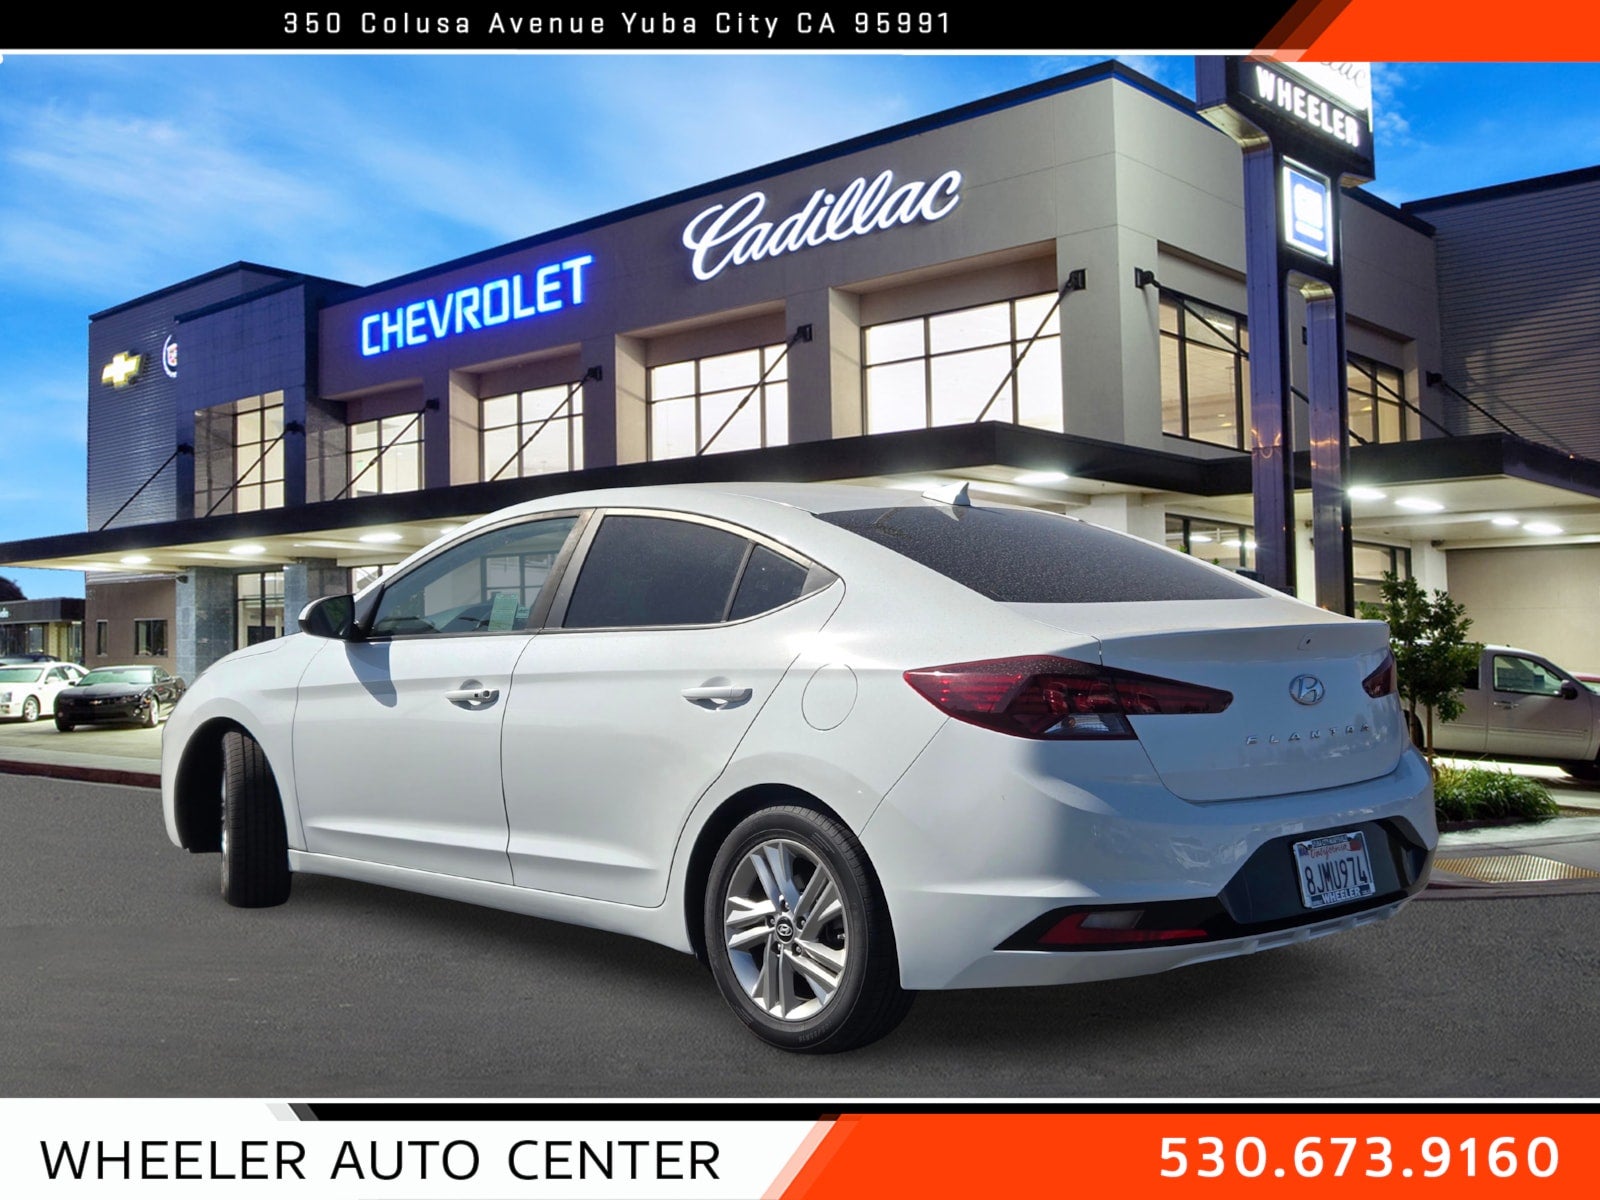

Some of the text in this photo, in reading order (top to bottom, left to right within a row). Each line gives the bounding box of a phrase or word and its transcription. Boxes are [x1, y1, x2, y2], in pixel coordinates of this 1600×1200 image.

[1255, 65, 1360, 147] WHEELER
[682, 168, 963, 281] Cadillac
[360, 255, 594, 357] CHEVROLET
[1245, 723, 1370, 745] ELANTRA
[1304, 856, 1368, 895] 8JMU974
[1321, 887, 1361, 904] WHEELER
